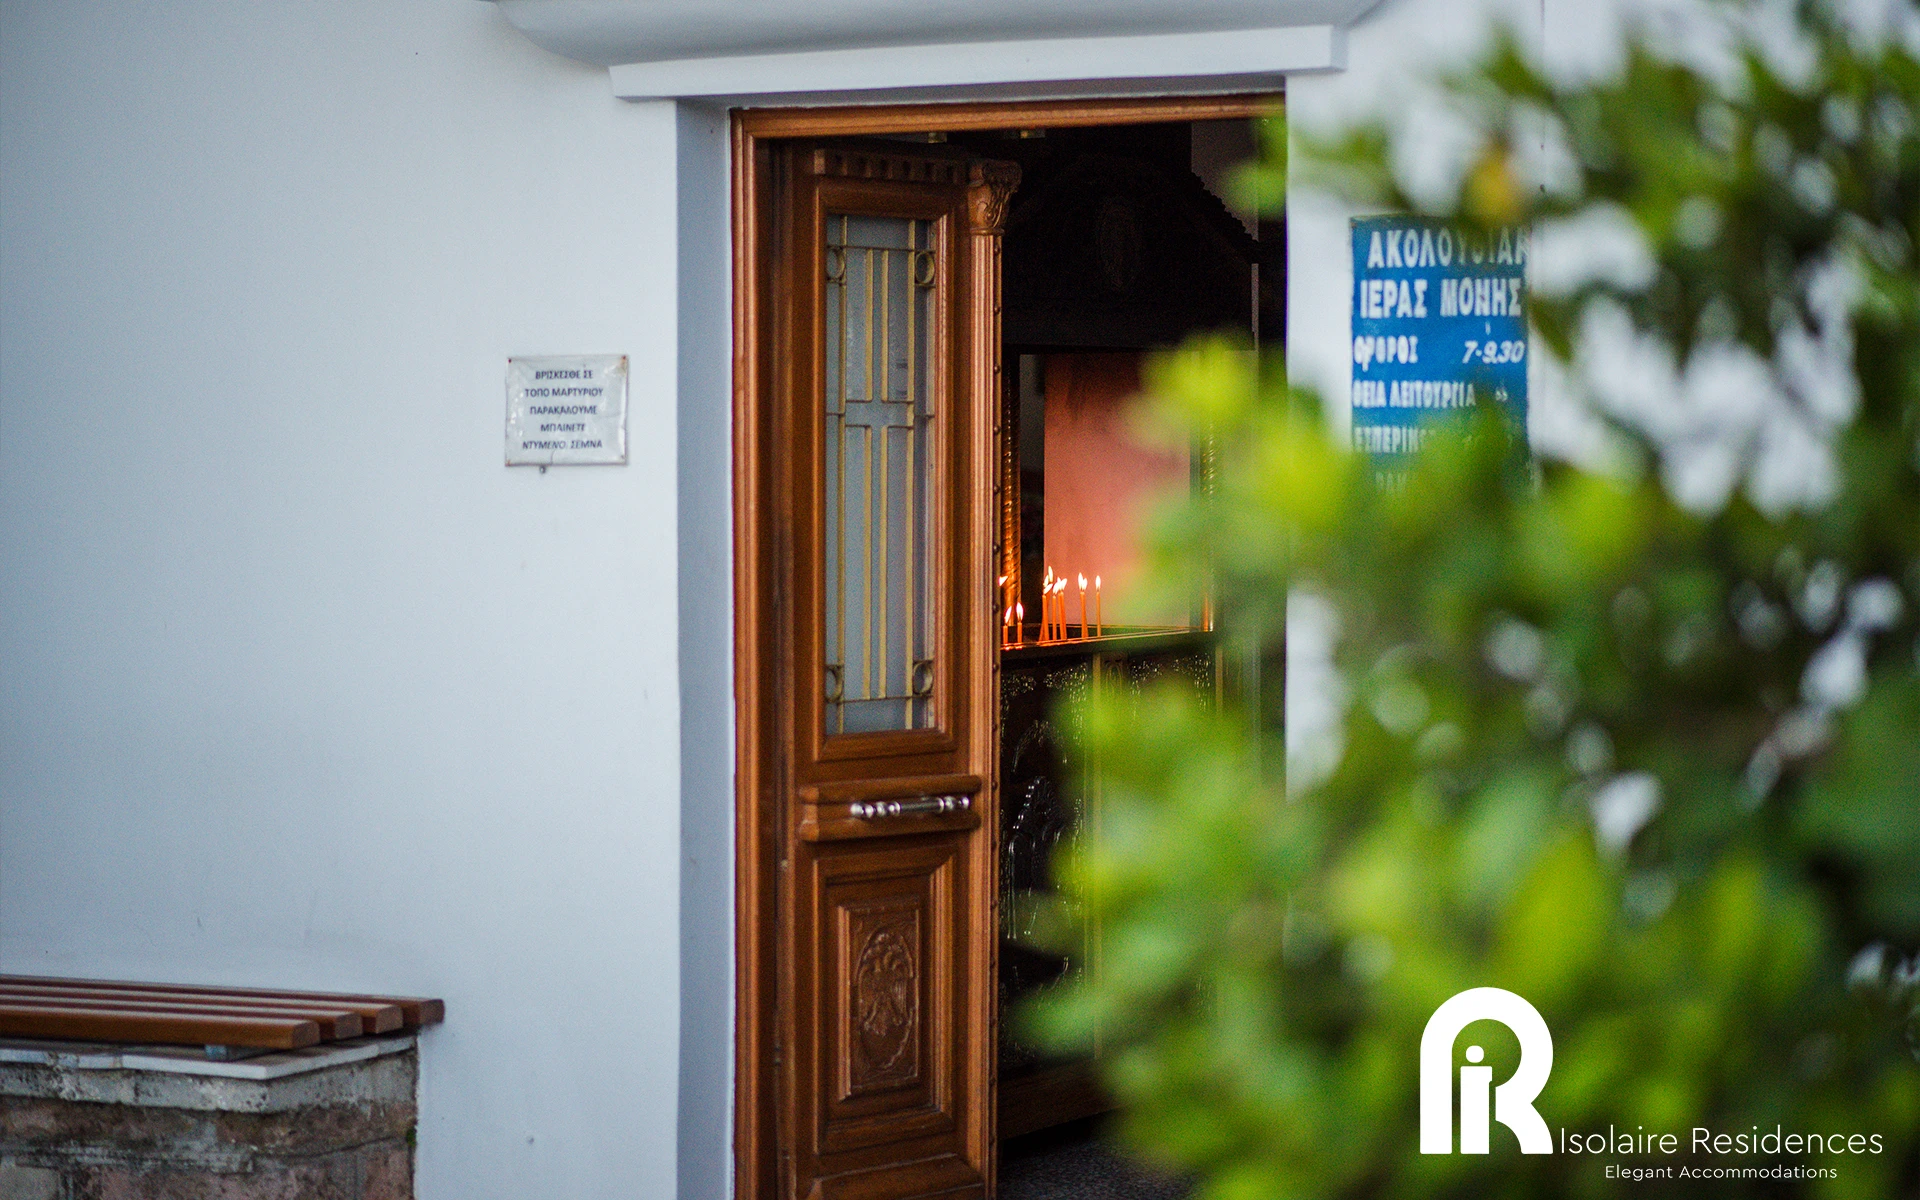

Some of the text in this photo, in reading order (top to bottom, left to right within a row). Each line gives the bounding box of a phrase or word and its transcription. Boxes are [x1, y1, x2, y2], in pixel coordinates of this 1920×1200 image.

[1360, 276, 1522, 319] ΙΕΡΑΣ ΜΟΝΗΣ
[535, 369, 594, 380] ΒΡΙΣΚΕΣΘΕ ΣΕ
[525, 387, 604, 397] ΤΟΠΟ ΜΑΡΤΥΡΙΟΥ
[529, 405, 598, 415] ΠΑΡΑΚΑΛΟΥΜΕ
[540, 423, 586, 432] ΜΠΑΙΝΕΤΕ
[570, 439, 603, 449] ΣΕΜΝΑ
